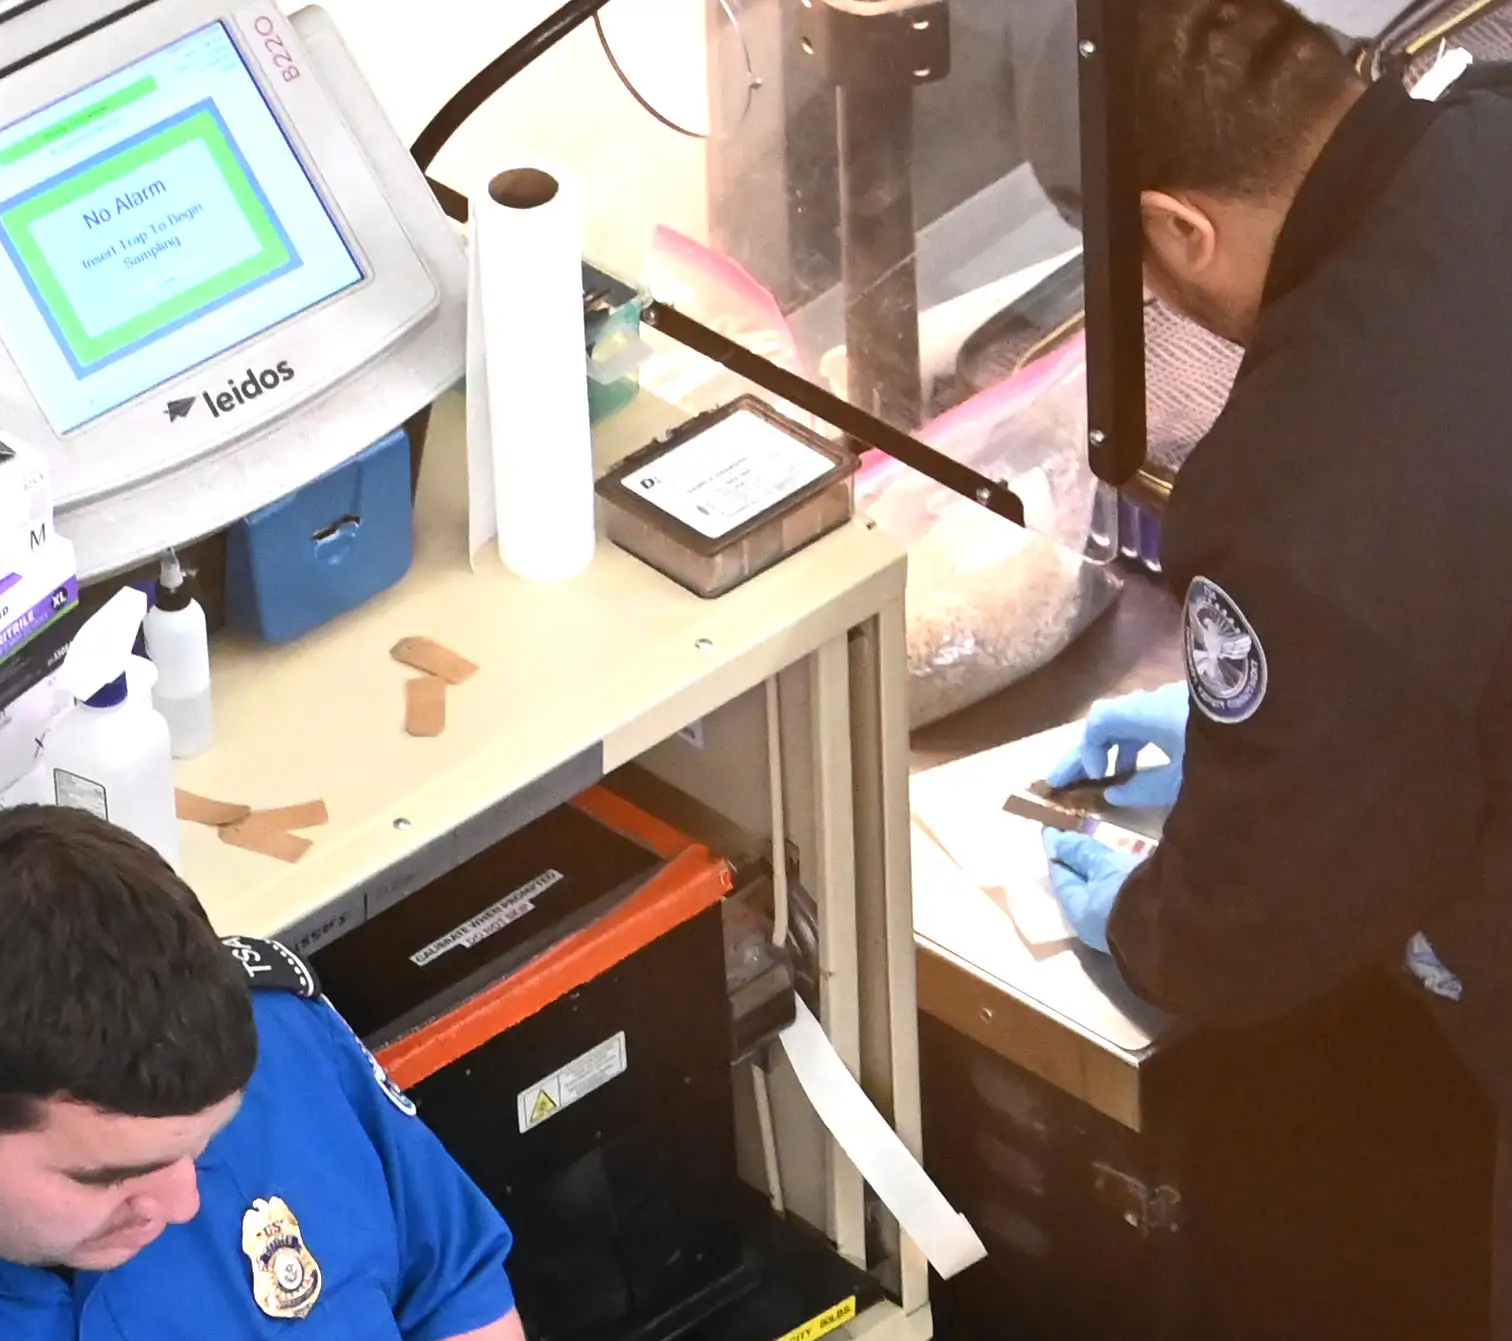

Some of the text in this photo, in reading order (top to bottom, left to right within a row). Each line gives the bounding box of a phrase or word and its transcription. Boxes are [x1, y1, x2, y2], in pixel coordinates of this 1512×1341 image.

[82, 176, 167, 231] No Alarm
[81, 244, 119, 271] Insert
[150, 218, 168, 237] To
[168, 201, 205, 232] Begin
[122, 233, 183, 271] Sampling
[201, 357, 295, 418] leidos
[29, 523, 47, 550] M
[52, 588, 68, 608] XL
[414, 870, 558, 964] CALIBRATE WHEN PROMPTED
[222, 936, 272, 978] TSA
